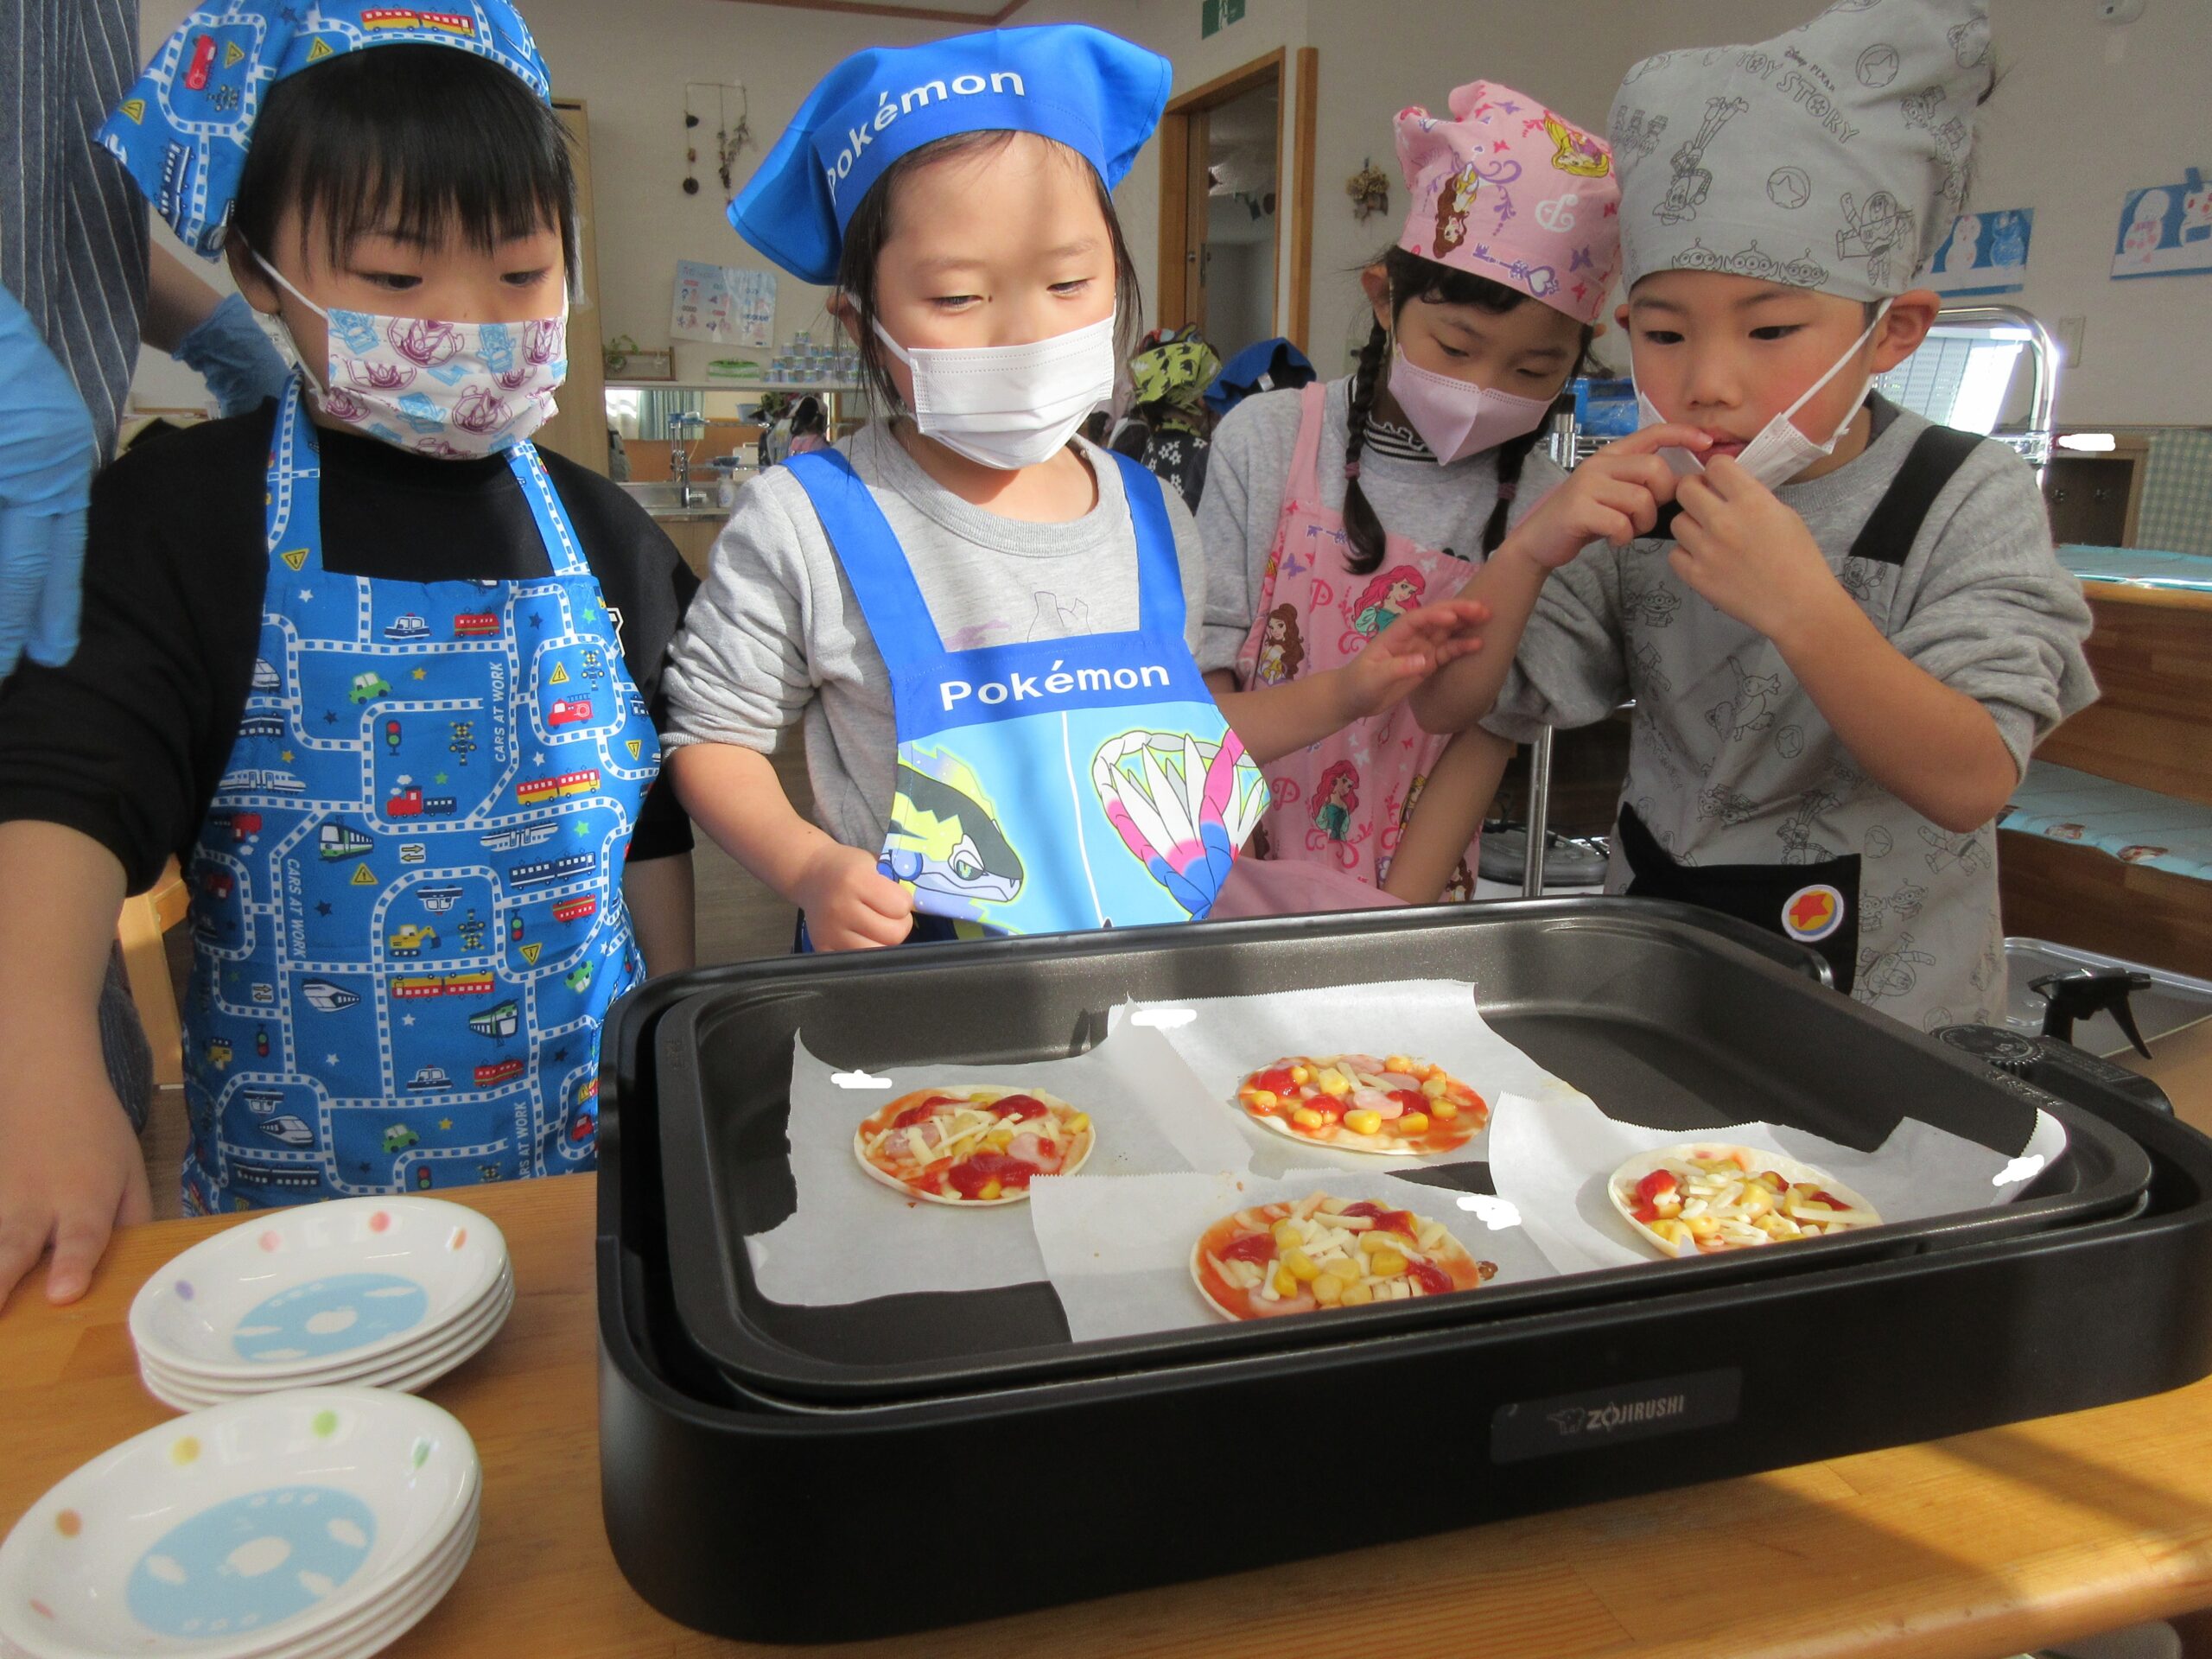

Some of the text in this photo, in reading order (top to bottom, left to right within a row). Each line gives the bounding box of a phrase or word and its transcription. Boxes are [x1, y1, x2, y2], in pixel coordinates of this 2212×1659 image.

[1736, 50, 1859, 144] TOY STORY
[1810, 63, 1835, 92] PIXAR
[827, 72, 1025, 207] Pokémon
[939, 659, 1171, 711] Pokémon
[489, 661, 506, 762] CARS AT WORK
[287, 858, 307, 959] CARS AT WORK
[514, 1101, 530, 1139] WORK
[518, 1141, 531, 1155] AT
[1586, 1395, 1685, 1433] ZOJIRUSHI
